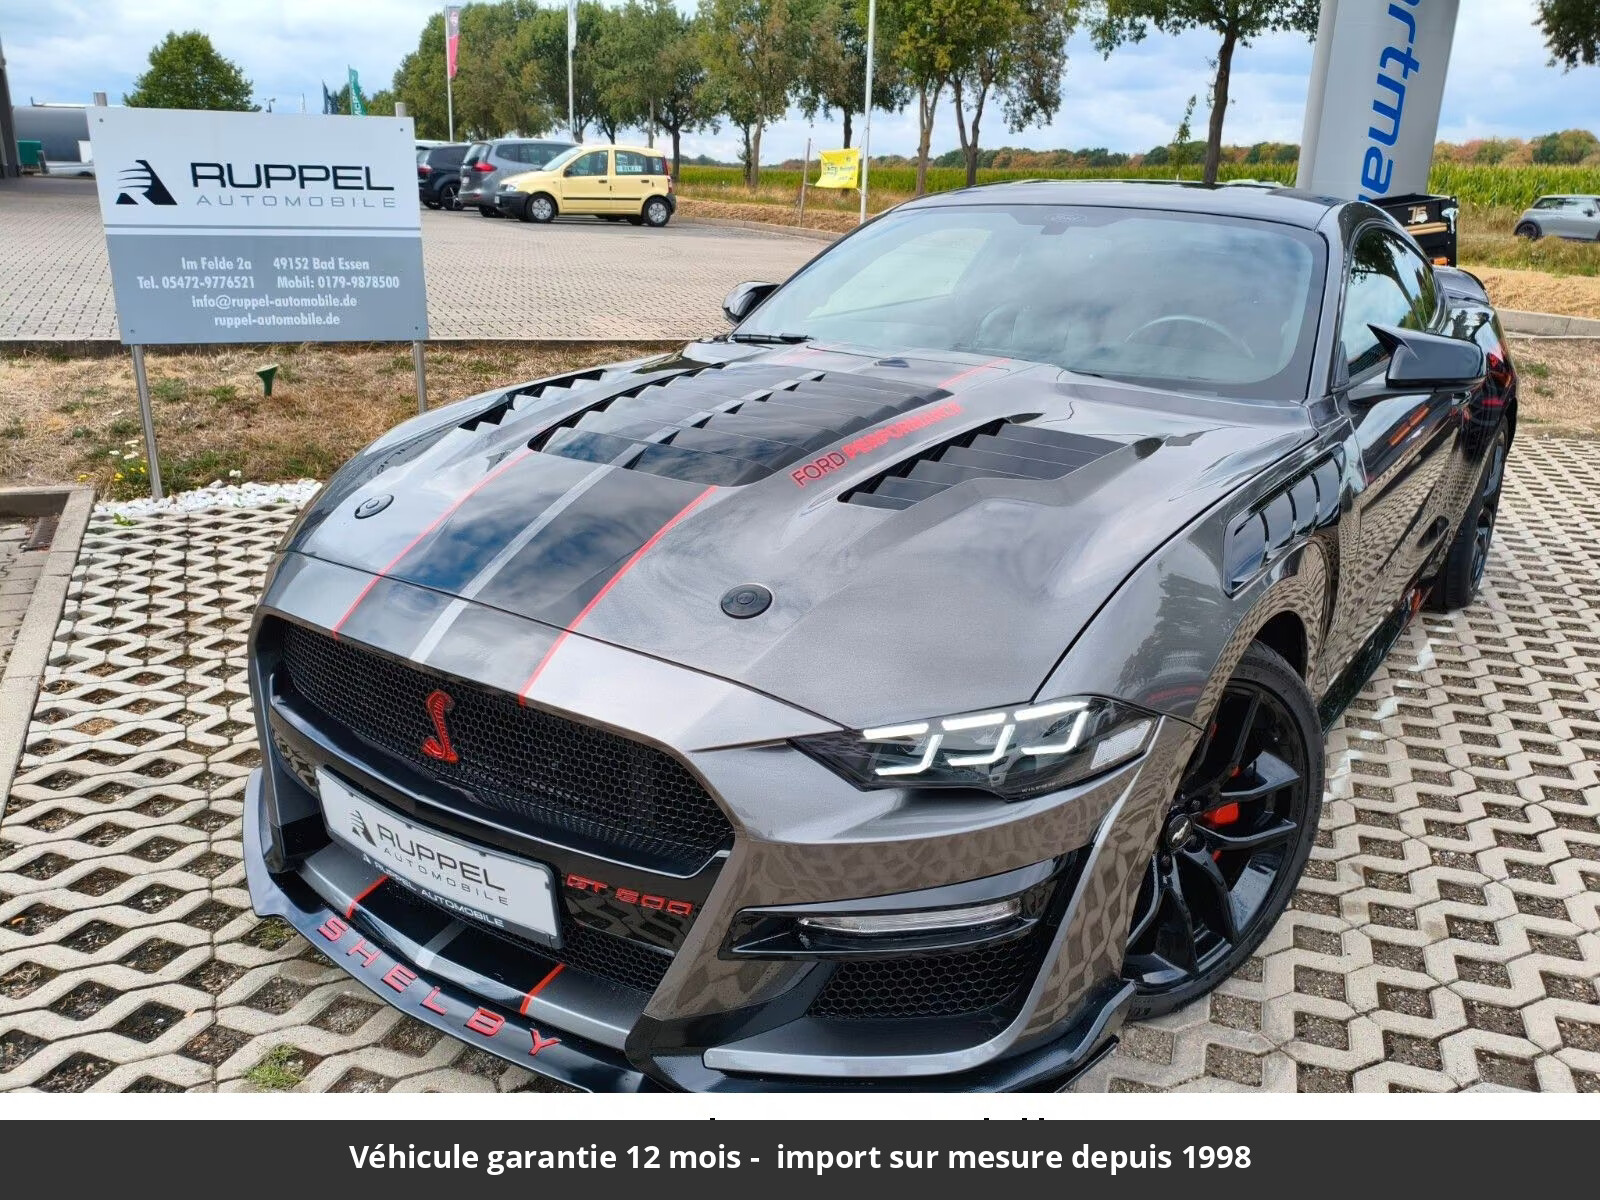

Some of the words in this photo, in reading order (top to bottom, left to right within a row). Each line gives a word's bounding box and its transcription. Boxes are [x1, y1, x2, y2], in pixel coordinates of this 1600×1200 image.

[1358, 0, 1420, 201] rtma
[190, 162, 394, 191] RUPPEL
[196, 194, 396, 208] AUTOMOBILE
[182, 257, 197, 270] Im
[201, 256, 234, 270] Felde
[237, 257, 252, 270] 2a
[273, 257, 309, 270] 49152
[313, 257, 335, 270] Bad
[338, 257, 370, 270] Essen
[137, 276, 159, 289] Tel.
[162, 276, 255, 289] 05472-9776521
[277, 275, 314, 289] Mobil:
[318, 275, 400, 289] 0179-9878500
[192, 295, 358, 309] info@ruppel-automobile.de
[214, 312, 340, 328] ruppel-automobile.de
[790, 451, 846, 488] FORD
[377, 823, 505, 891] RUPPEL
[383, 847, 508, 906] AUTOMOBILE
[566, 873, 608, 894] GT
[615, 887, 693, 917] 500
[421, 889, 505, 928] AUTOMOBILE
[317, 915, 561, 1056] SHELBY
